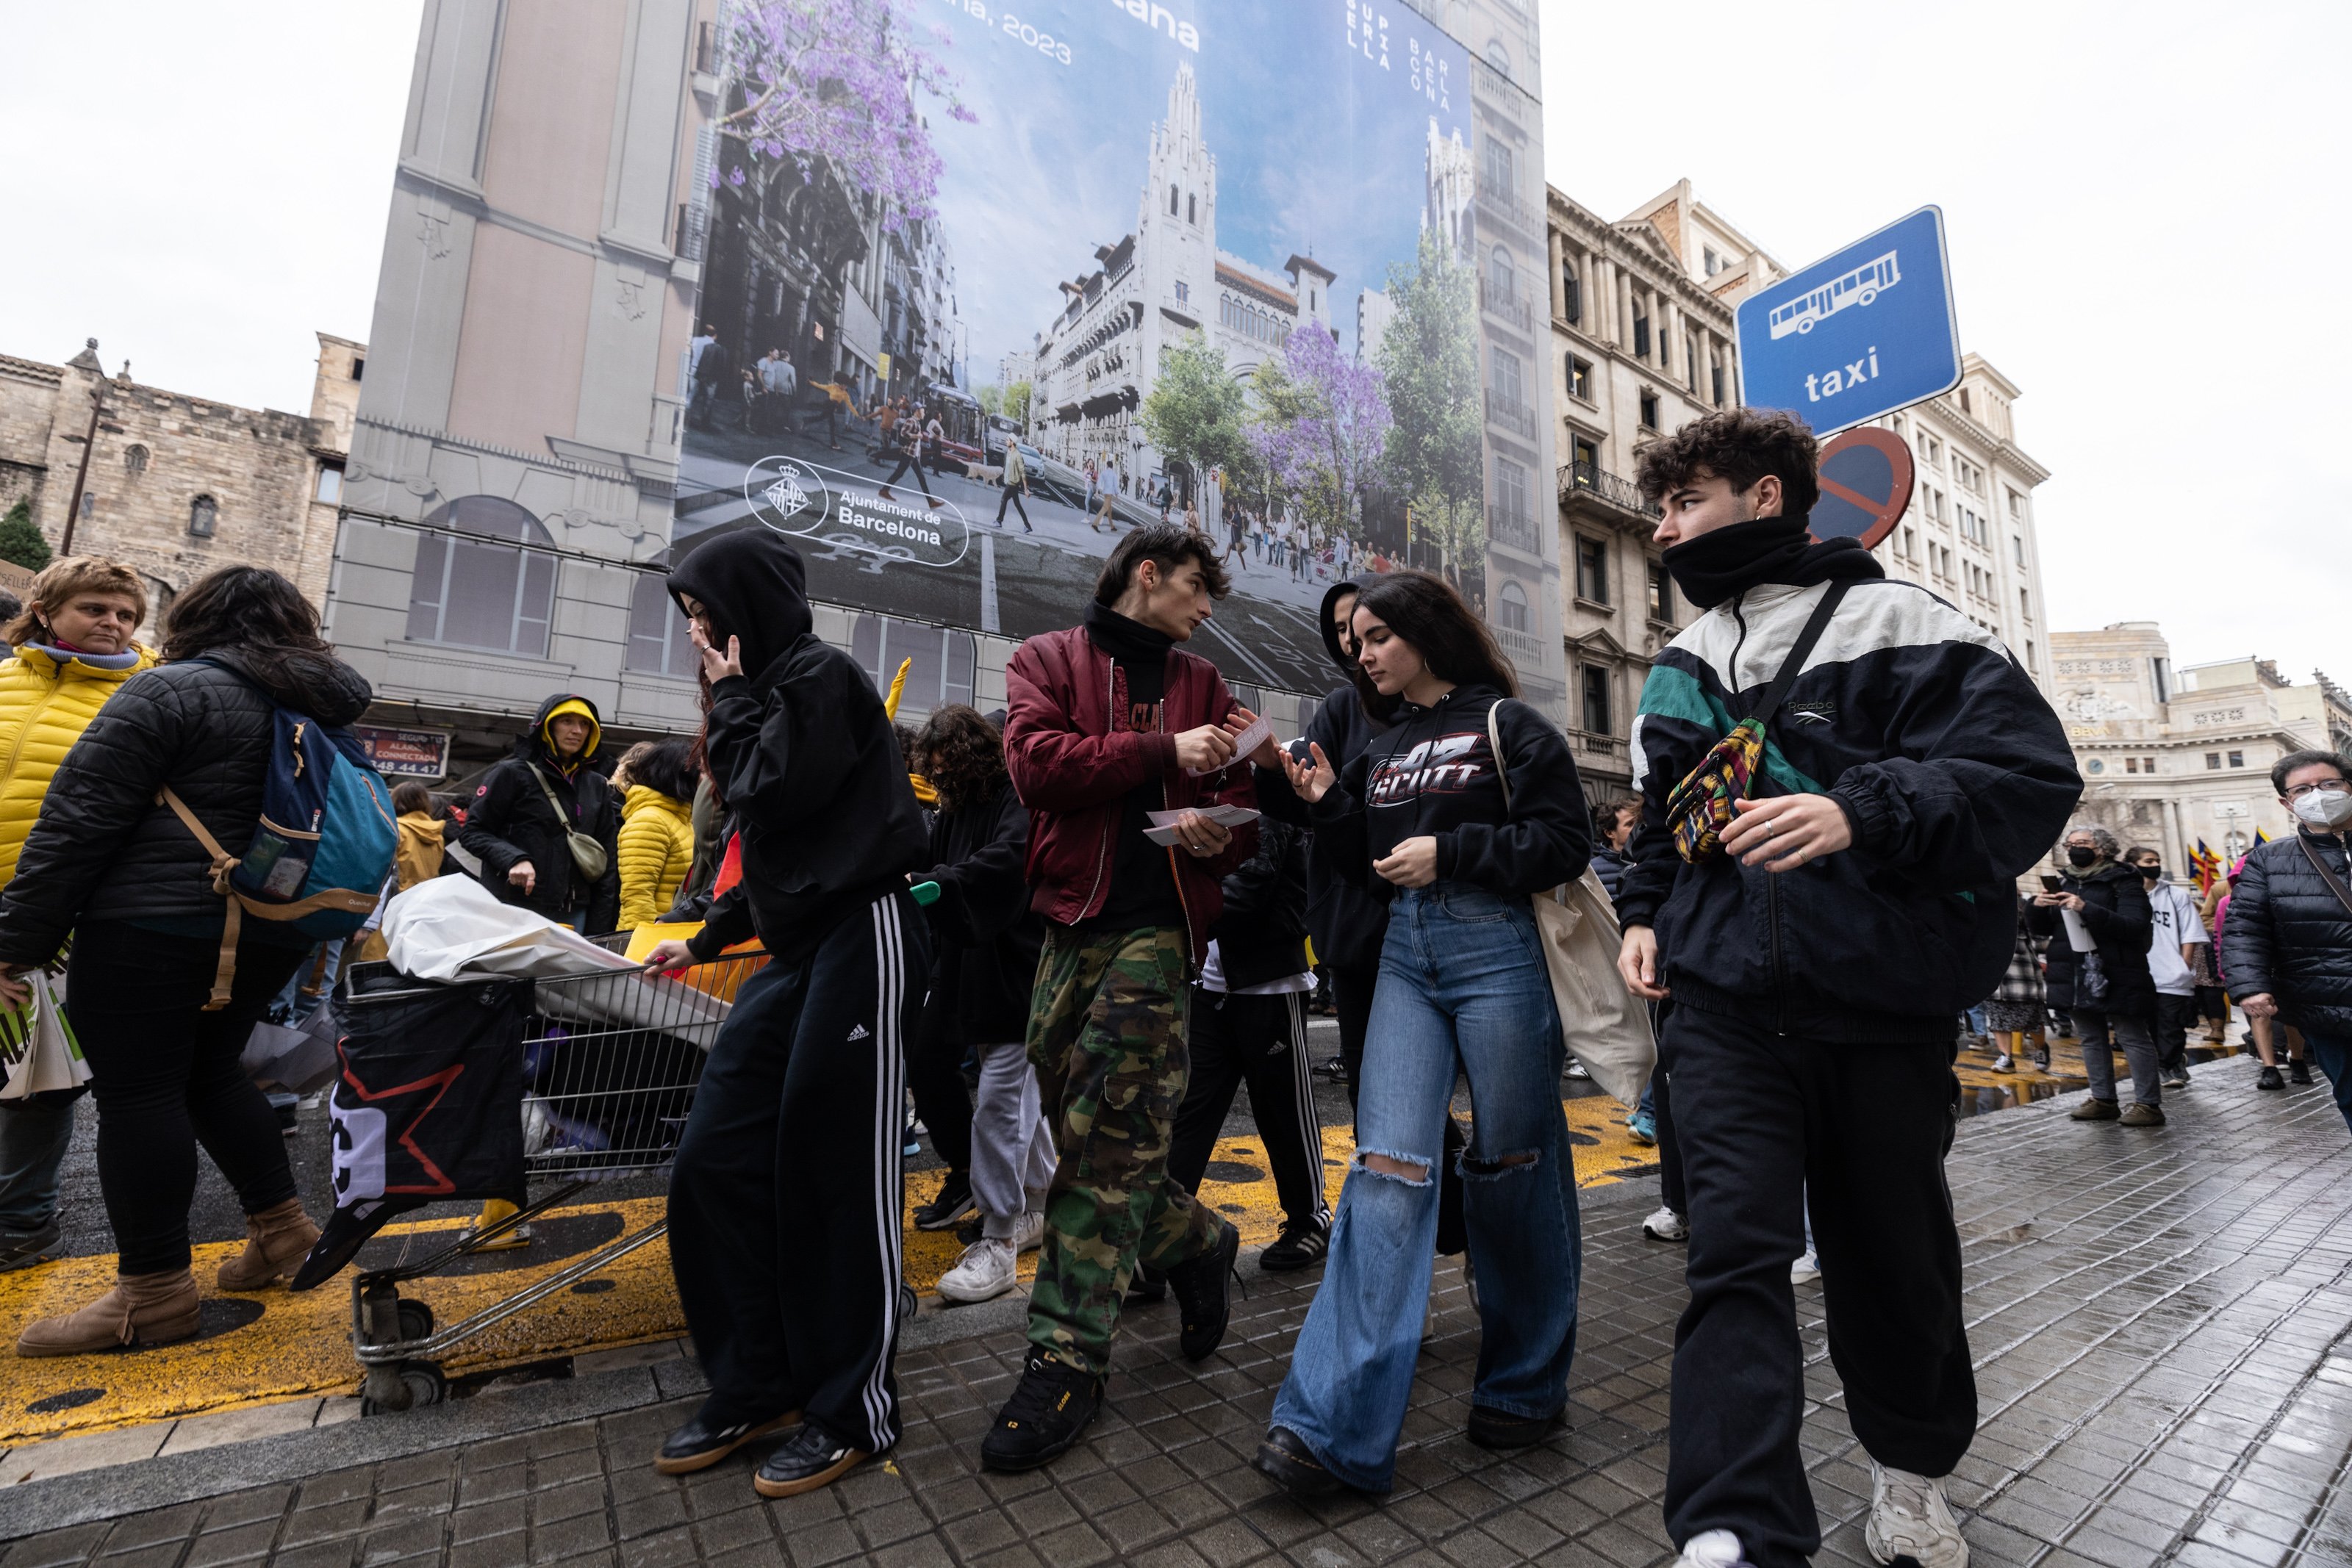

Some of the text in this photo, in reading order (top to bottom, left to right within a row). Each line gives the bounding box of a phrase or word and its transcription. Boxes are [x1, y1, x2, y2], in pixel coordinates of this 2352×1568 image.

[1003, 14, 1072, 65] 2023
[1804, 345, 1879, 403] taxi
[840, 490, 942, 525] Ajuntament de
[839, 506, 941, 546] Barcelona
[1261, 641, 1338, 668] BU
[2071, 725, 2112, 737] BBVA
[376, 750, 437, 763] CONNECTADA
[398, 763, 417, 773] 44
[420, 765, 440, 774] 47
[847, 1030, 870, 1042] adidas
[1057, 1390, 1071, 1411] GLOBE
